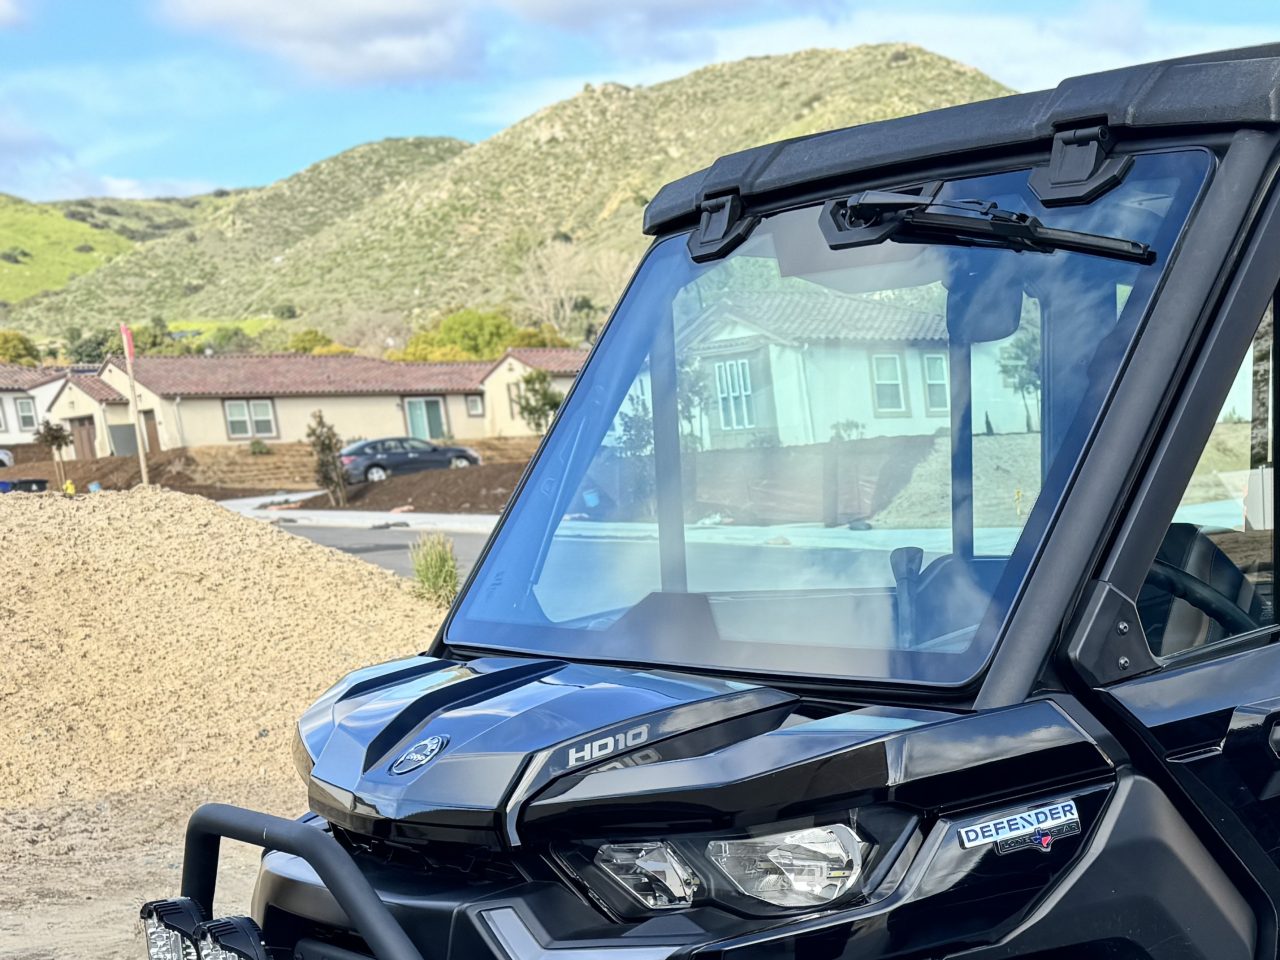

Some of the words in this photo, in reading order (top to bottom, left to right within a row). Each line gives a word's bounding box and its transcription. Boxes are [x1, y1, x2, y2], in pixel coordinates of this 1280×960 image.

[568, 723, 650, 767] HD10
[964, 803, 1075, 844] DEFENDER
[1001, 836, 1031, 850] LONE
[1050, 823, 1079, 837] STAR
